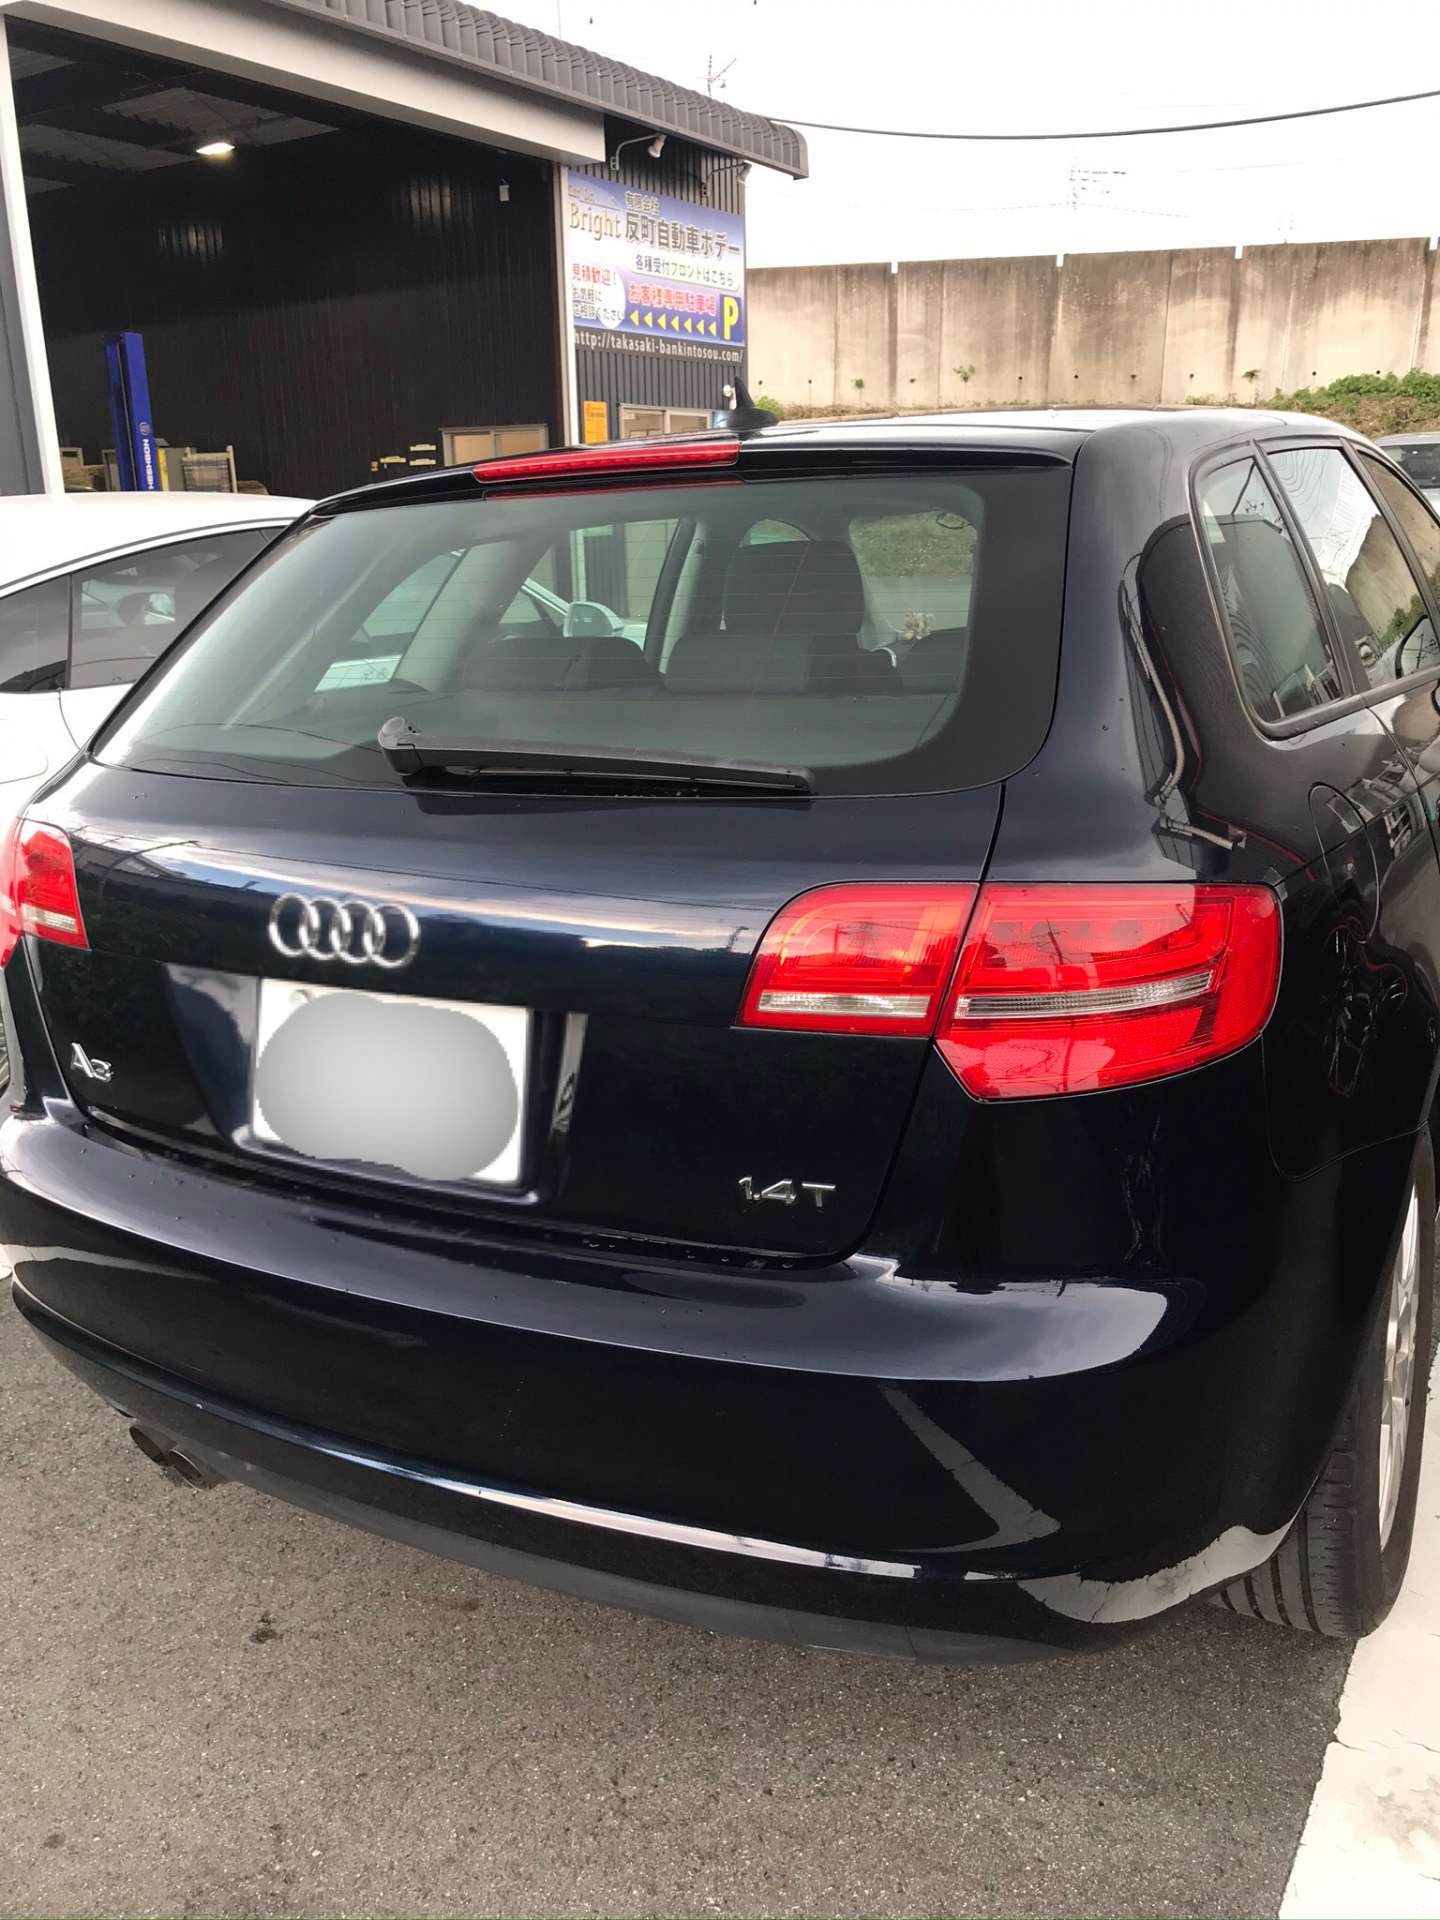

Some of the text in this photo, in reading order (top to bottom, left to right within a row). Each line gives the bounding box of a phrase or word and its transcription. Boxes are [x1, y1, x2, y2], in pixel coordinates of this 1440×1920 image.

[570, 203, 620, 240] Bright
[625, 212, 740, 258] 反町自動車ボデー
[635, 253, 734, 288] 各種受付フロントはこちら
[628, 281, 717, 316] お客様専用駐車場
[723, 296, 739, 340] P
[574, 330, 743, 363] http://takasaki-bankintosou.com/
[70, 1042, 113, 1082] A3
